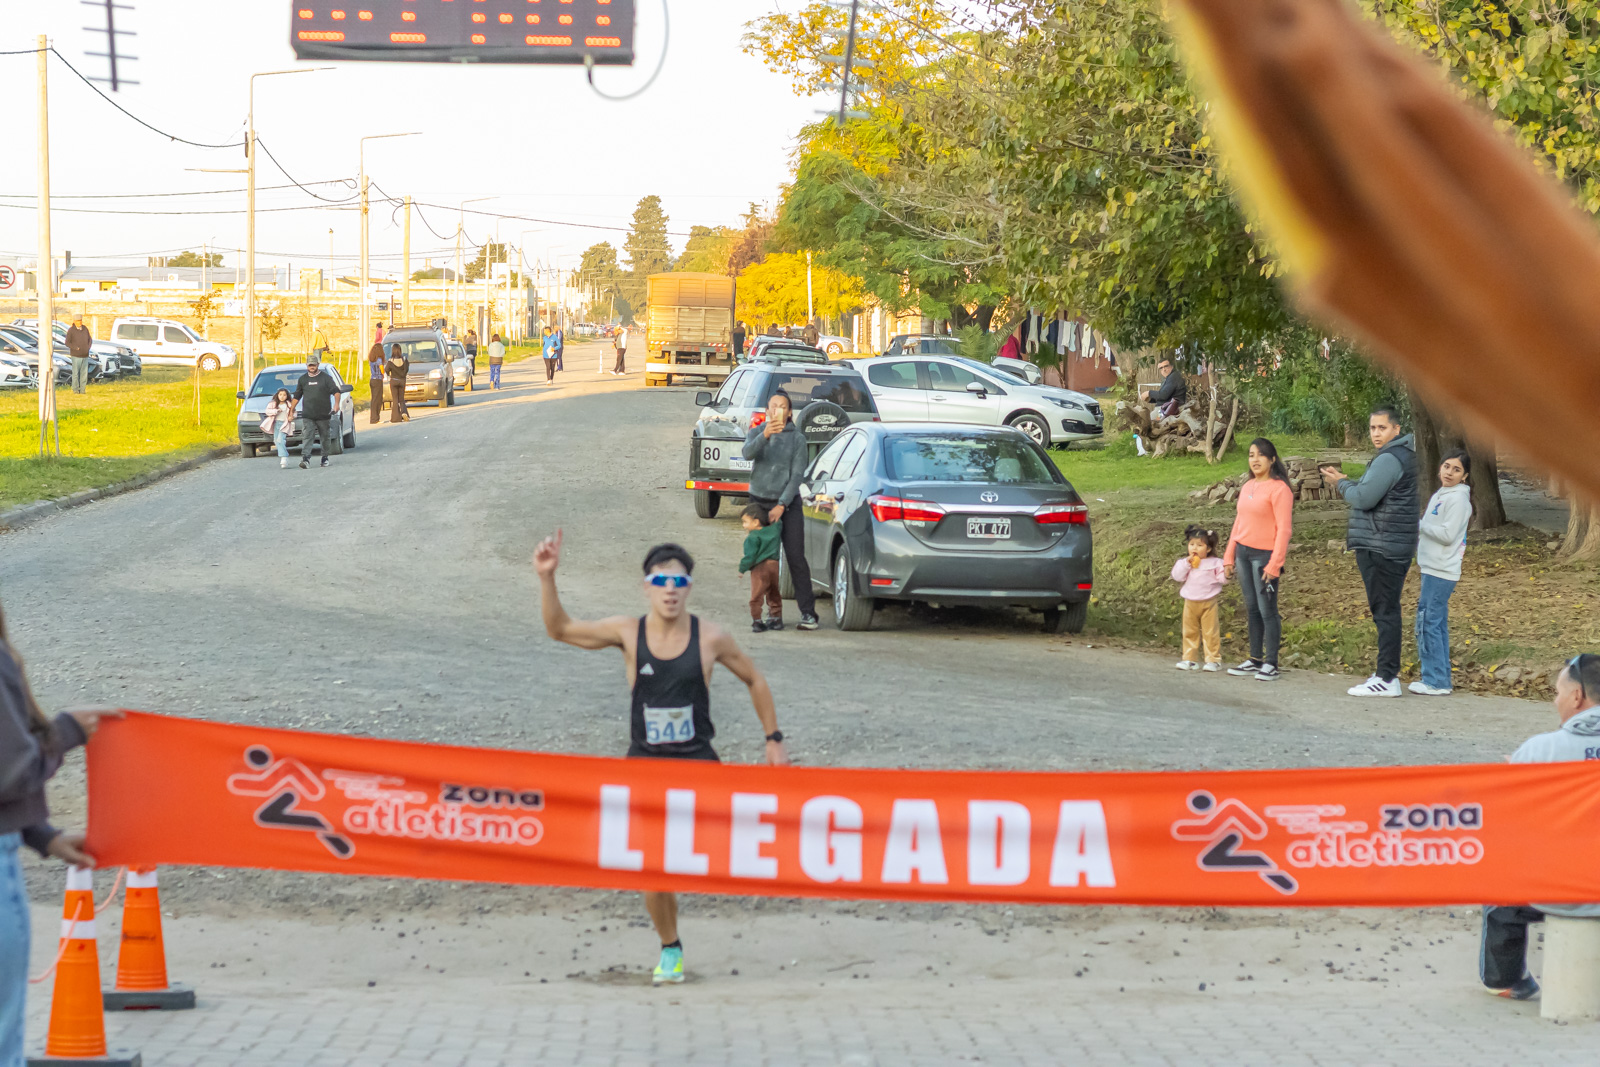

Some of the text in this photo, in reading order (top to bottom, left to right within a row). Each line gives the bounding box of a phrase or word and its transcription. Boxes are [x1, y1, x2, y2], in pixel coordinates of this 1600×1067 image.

[703, 446, 721, 461] 80
[735, 461, 752, 469] NDU1
[969, 523, 1010, 535] PKT 477
[647, 720, 692, 741] 544
[441, 783, 542, 807] zona
[346, 799, 541, 843] atletismo
[1383, 805, 1482, 828] zona
[598, 784, 1117, 888] LLEGADA
[1288, 831, 1482, 866] atletismo
